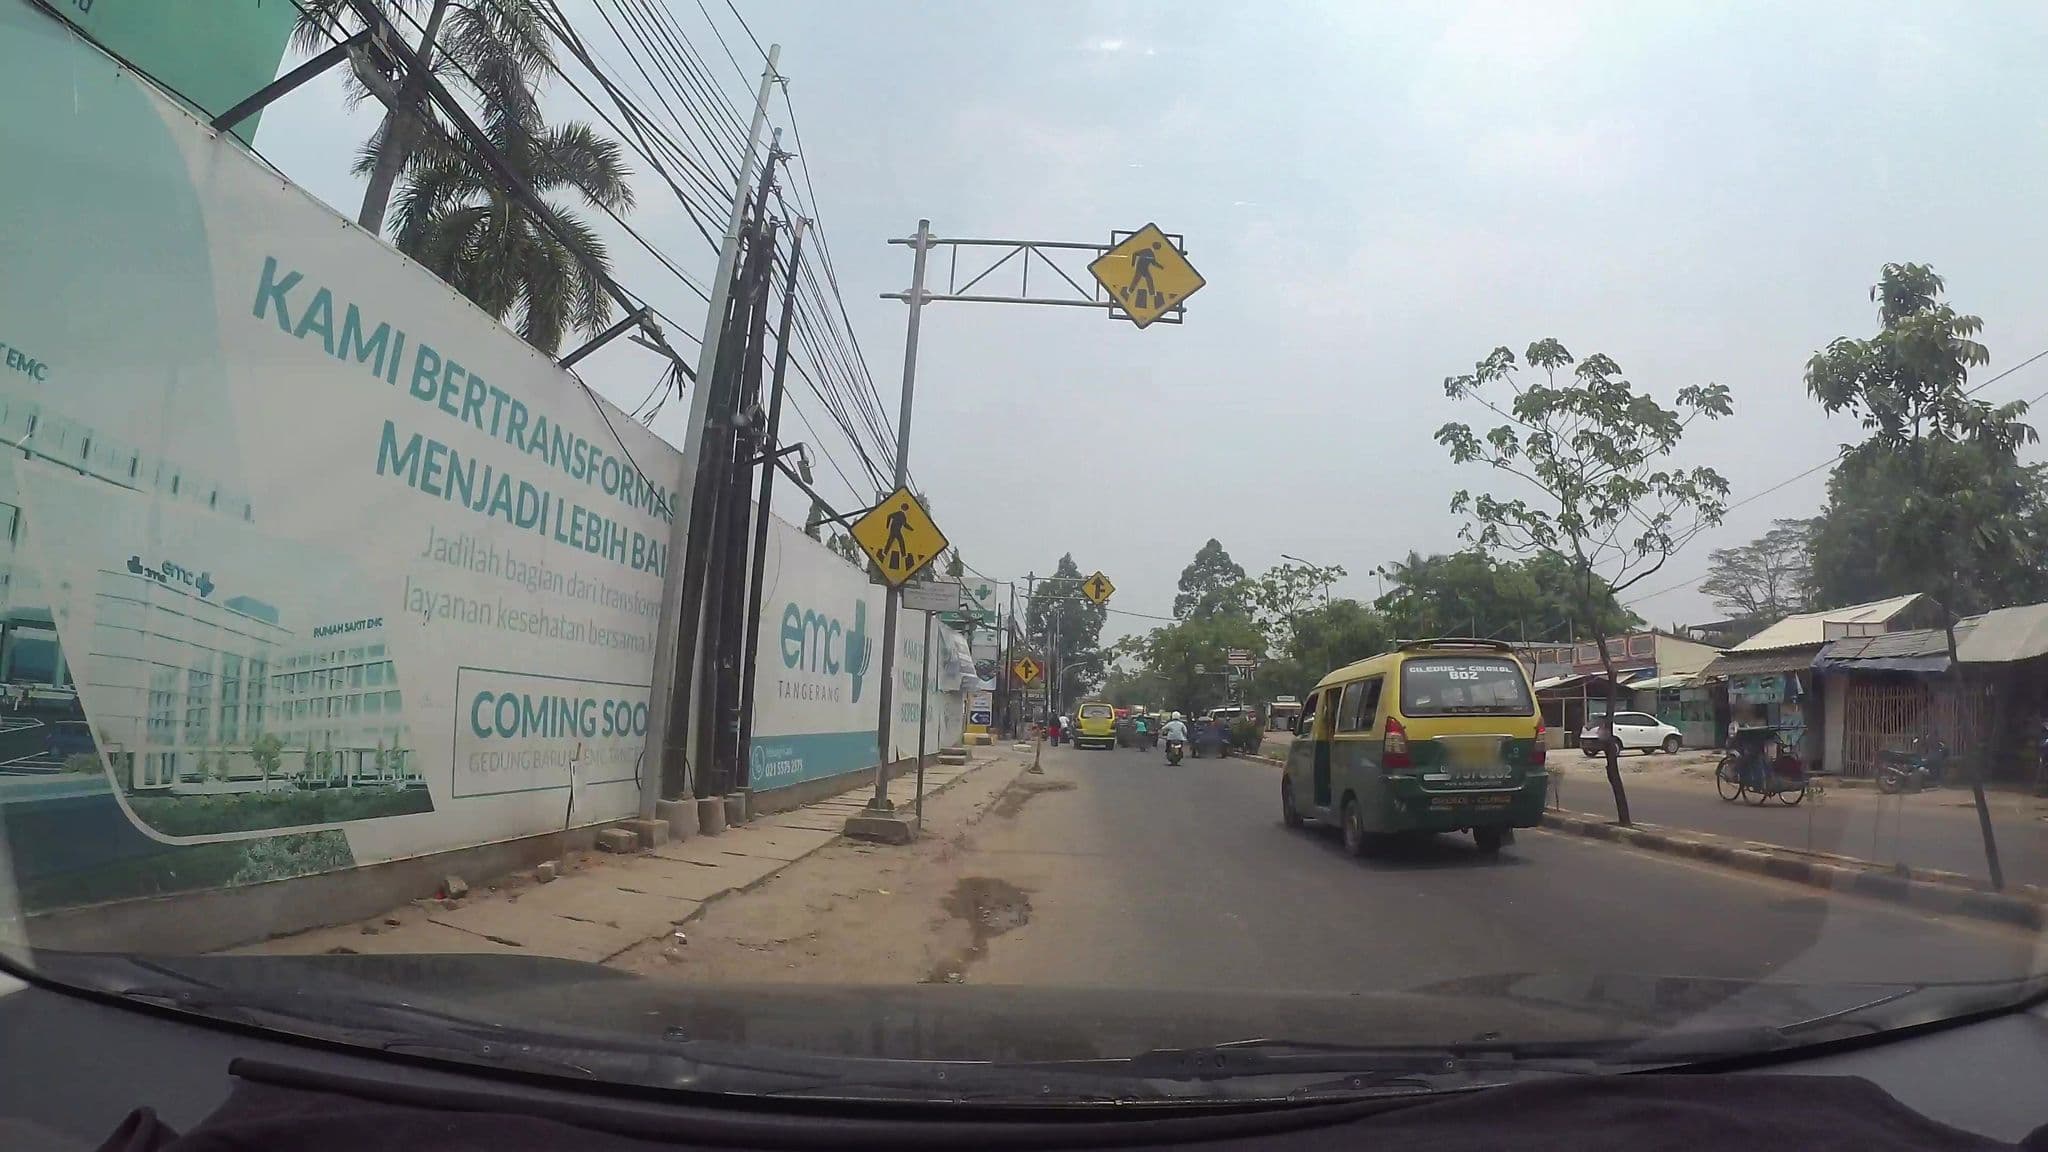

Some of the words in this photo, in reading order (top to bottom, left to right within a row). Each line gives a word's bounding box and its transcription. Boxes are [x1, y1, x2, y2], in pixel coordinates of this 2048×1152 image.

[252, 255, 406, 386] KAMI
[6, 347, 48, 381] EMC
[376, 419, 550, 537] MENJADI
[554, 496, 629, 566] LEBIH
[421, 525, 500, 577] Jadilah
[505, 548, 564, 594] bagian
[567, 570, 597, 604] dari
[313, 623, 344, 639] RUMAH
[344, 619, 367, 633] SAKIT
[366, 617, 384, 629] EMC
[403, 575, 492, 625] layanan
[497, 595, 585, 643] kesehatan
[588, 617, 647, 653] bersama
[781, 602, 841, 676] emc
[471, 691, 597, 739] COMING
[777, 680, 840, 703] TANGERANG
[469, 751, 531, 773] GEDUNG
